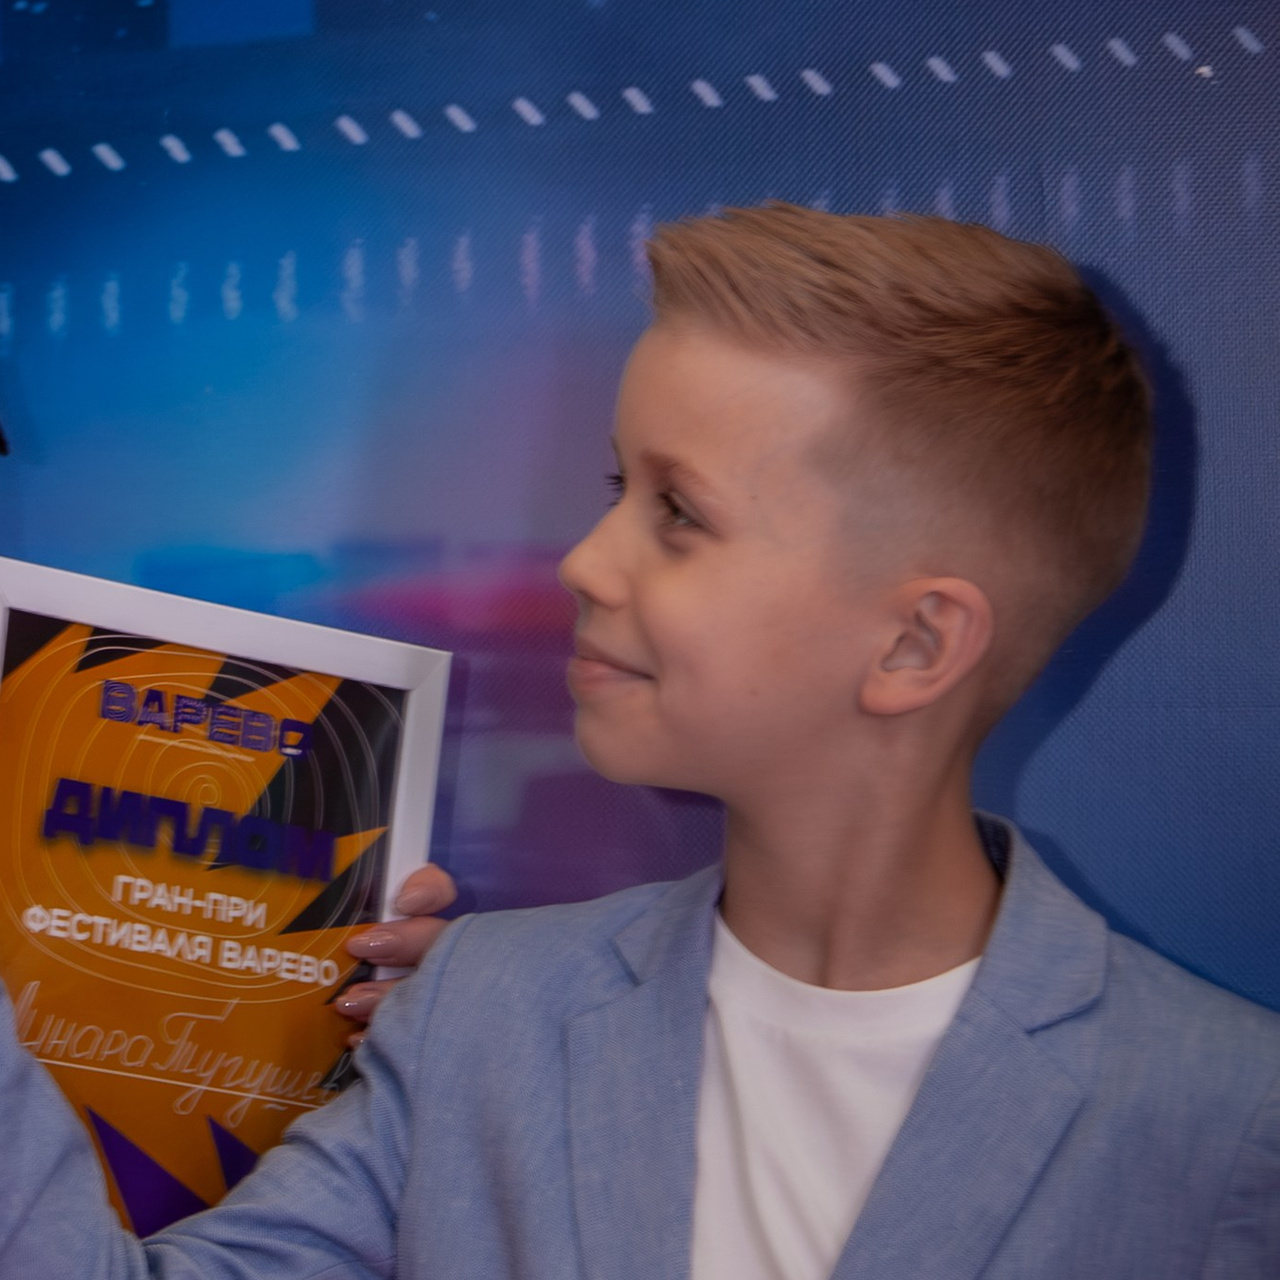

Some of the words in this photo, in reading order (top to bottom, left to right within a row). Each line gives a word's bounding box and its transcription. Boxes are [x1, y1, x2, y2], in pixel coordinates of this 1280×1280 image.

[100, 680, 314, 757] ВАРЕВО
[43, 777, 336, 883] ДИПЛОМ
[112, 874, 267, 929] ГРАН-ПРИ
[21, 904, 213, 964] ФЕСТИВАЛЯ
[219, 939, 340, 987] ВАРЕВО
